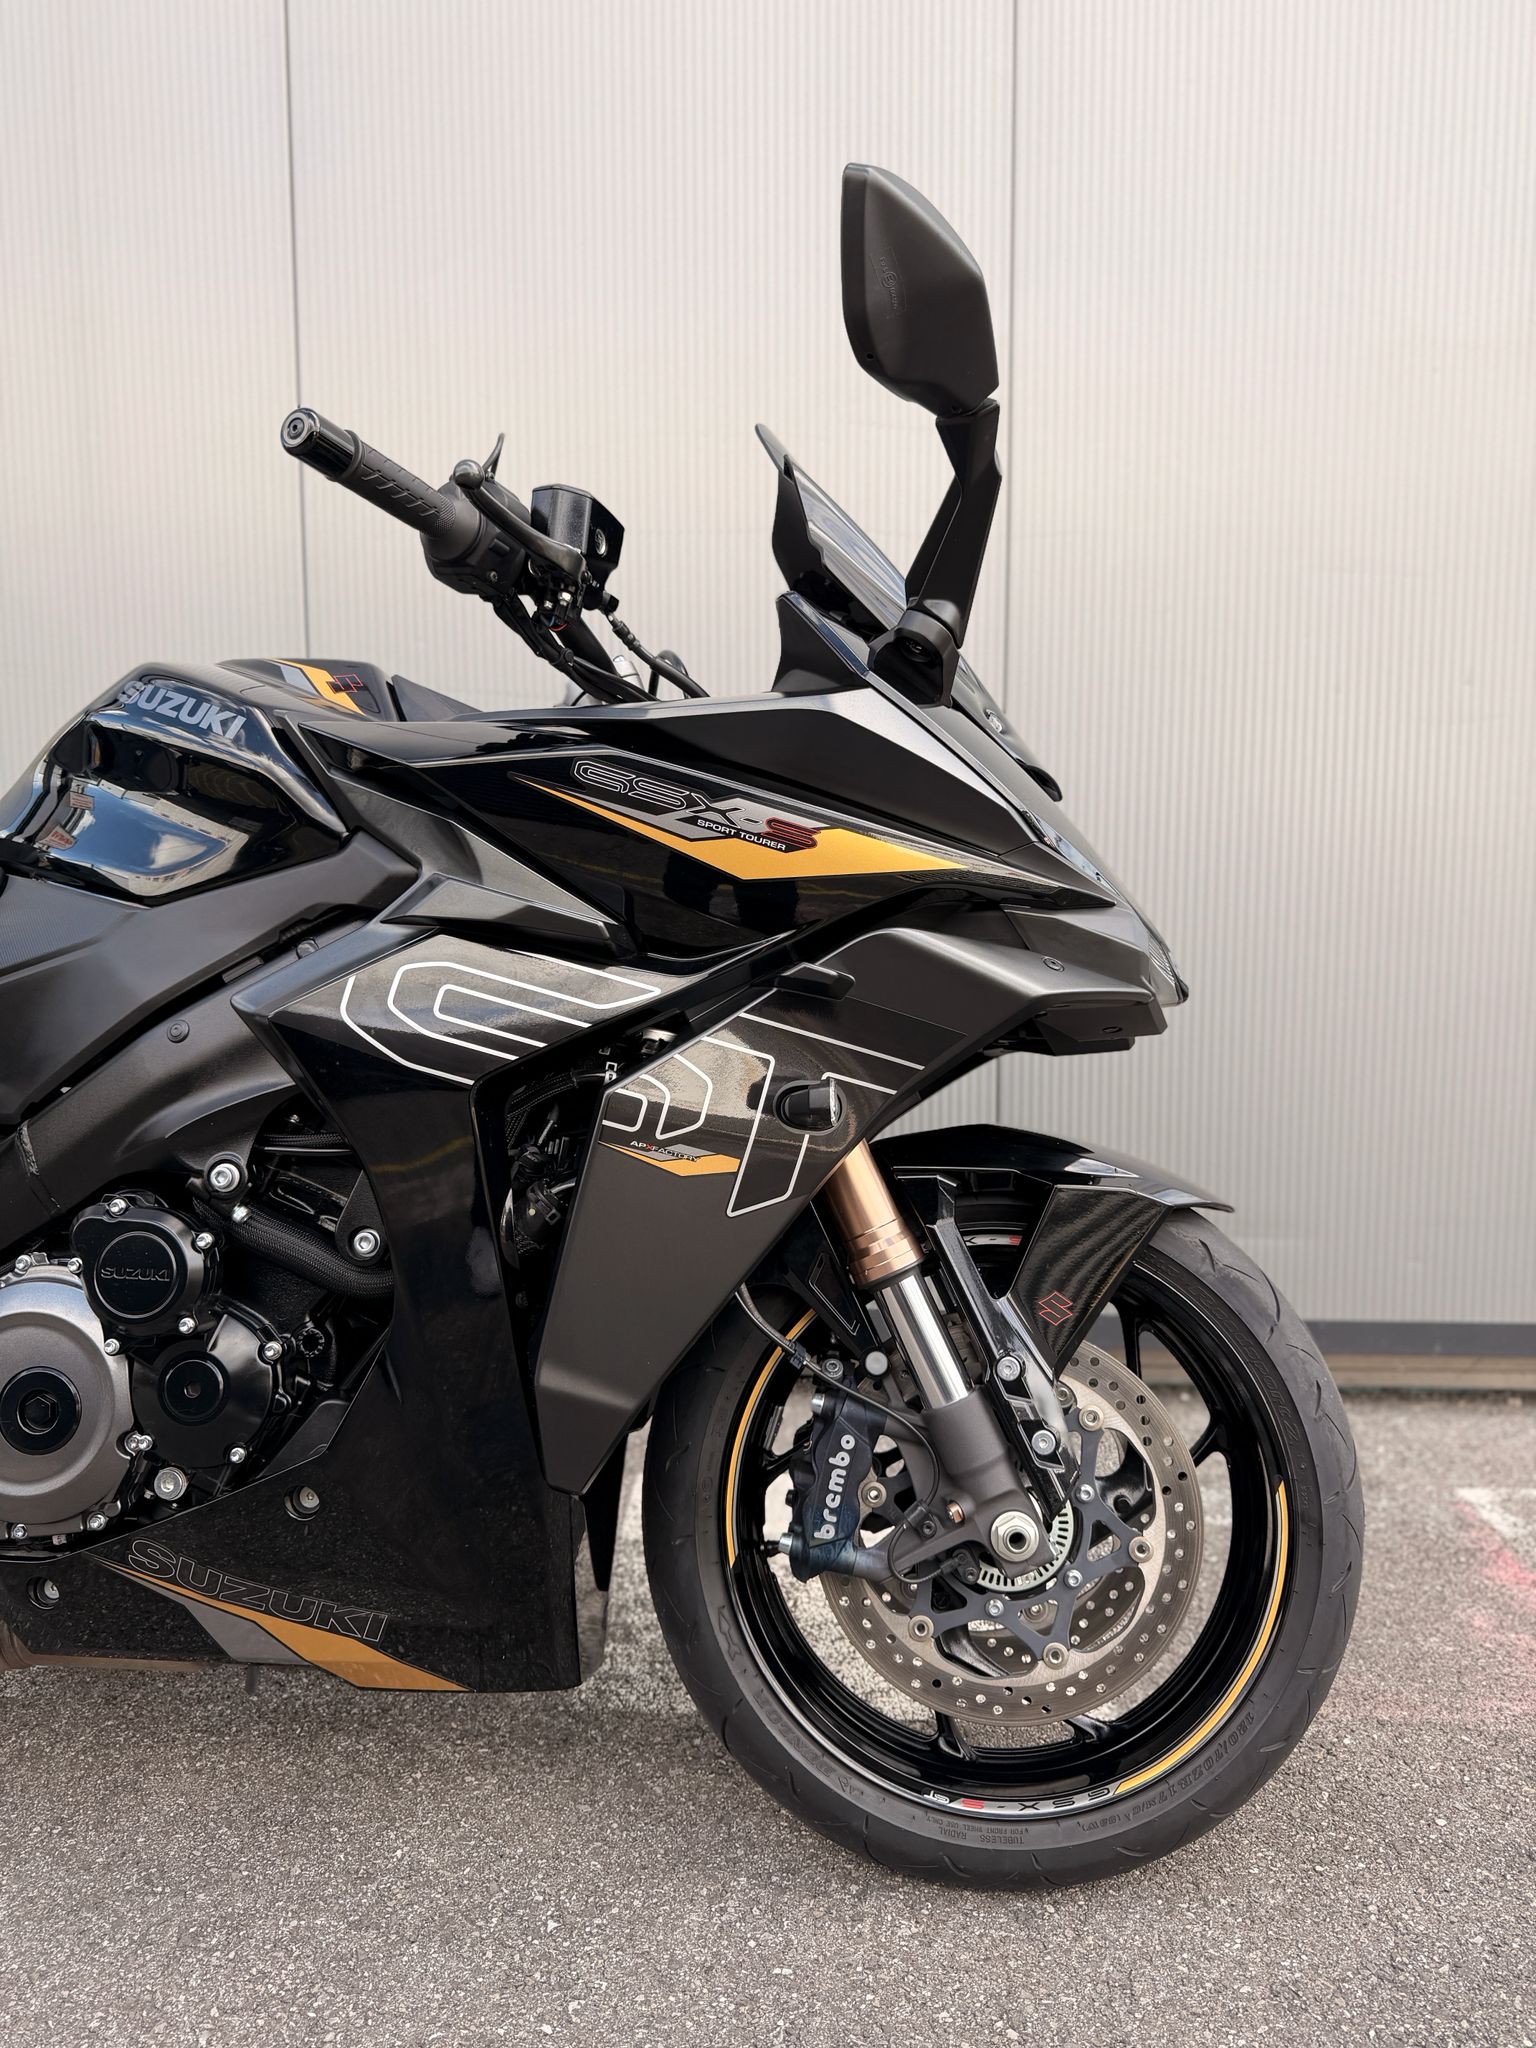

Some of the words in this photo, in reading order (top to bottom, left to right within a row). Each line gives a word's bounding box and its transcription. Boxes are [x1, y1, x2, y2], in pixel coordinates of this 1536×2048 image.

[116, 680, 247, 739] SUZUKI
[573, 760, 821, 849] GSX-S
[696, 818, 737, 836] SPORT
[739, 831, 786, 852] TOURER
[100, 1266, 171, 1282] SUZUKI
[813, 1434, 855, 1540] brembo
[128, 1539, 388, 1642] SUZUKI
[935, 1825, 968, 1840] RADIAL
[977, 1833, 1024, 1845] TUBELESS
